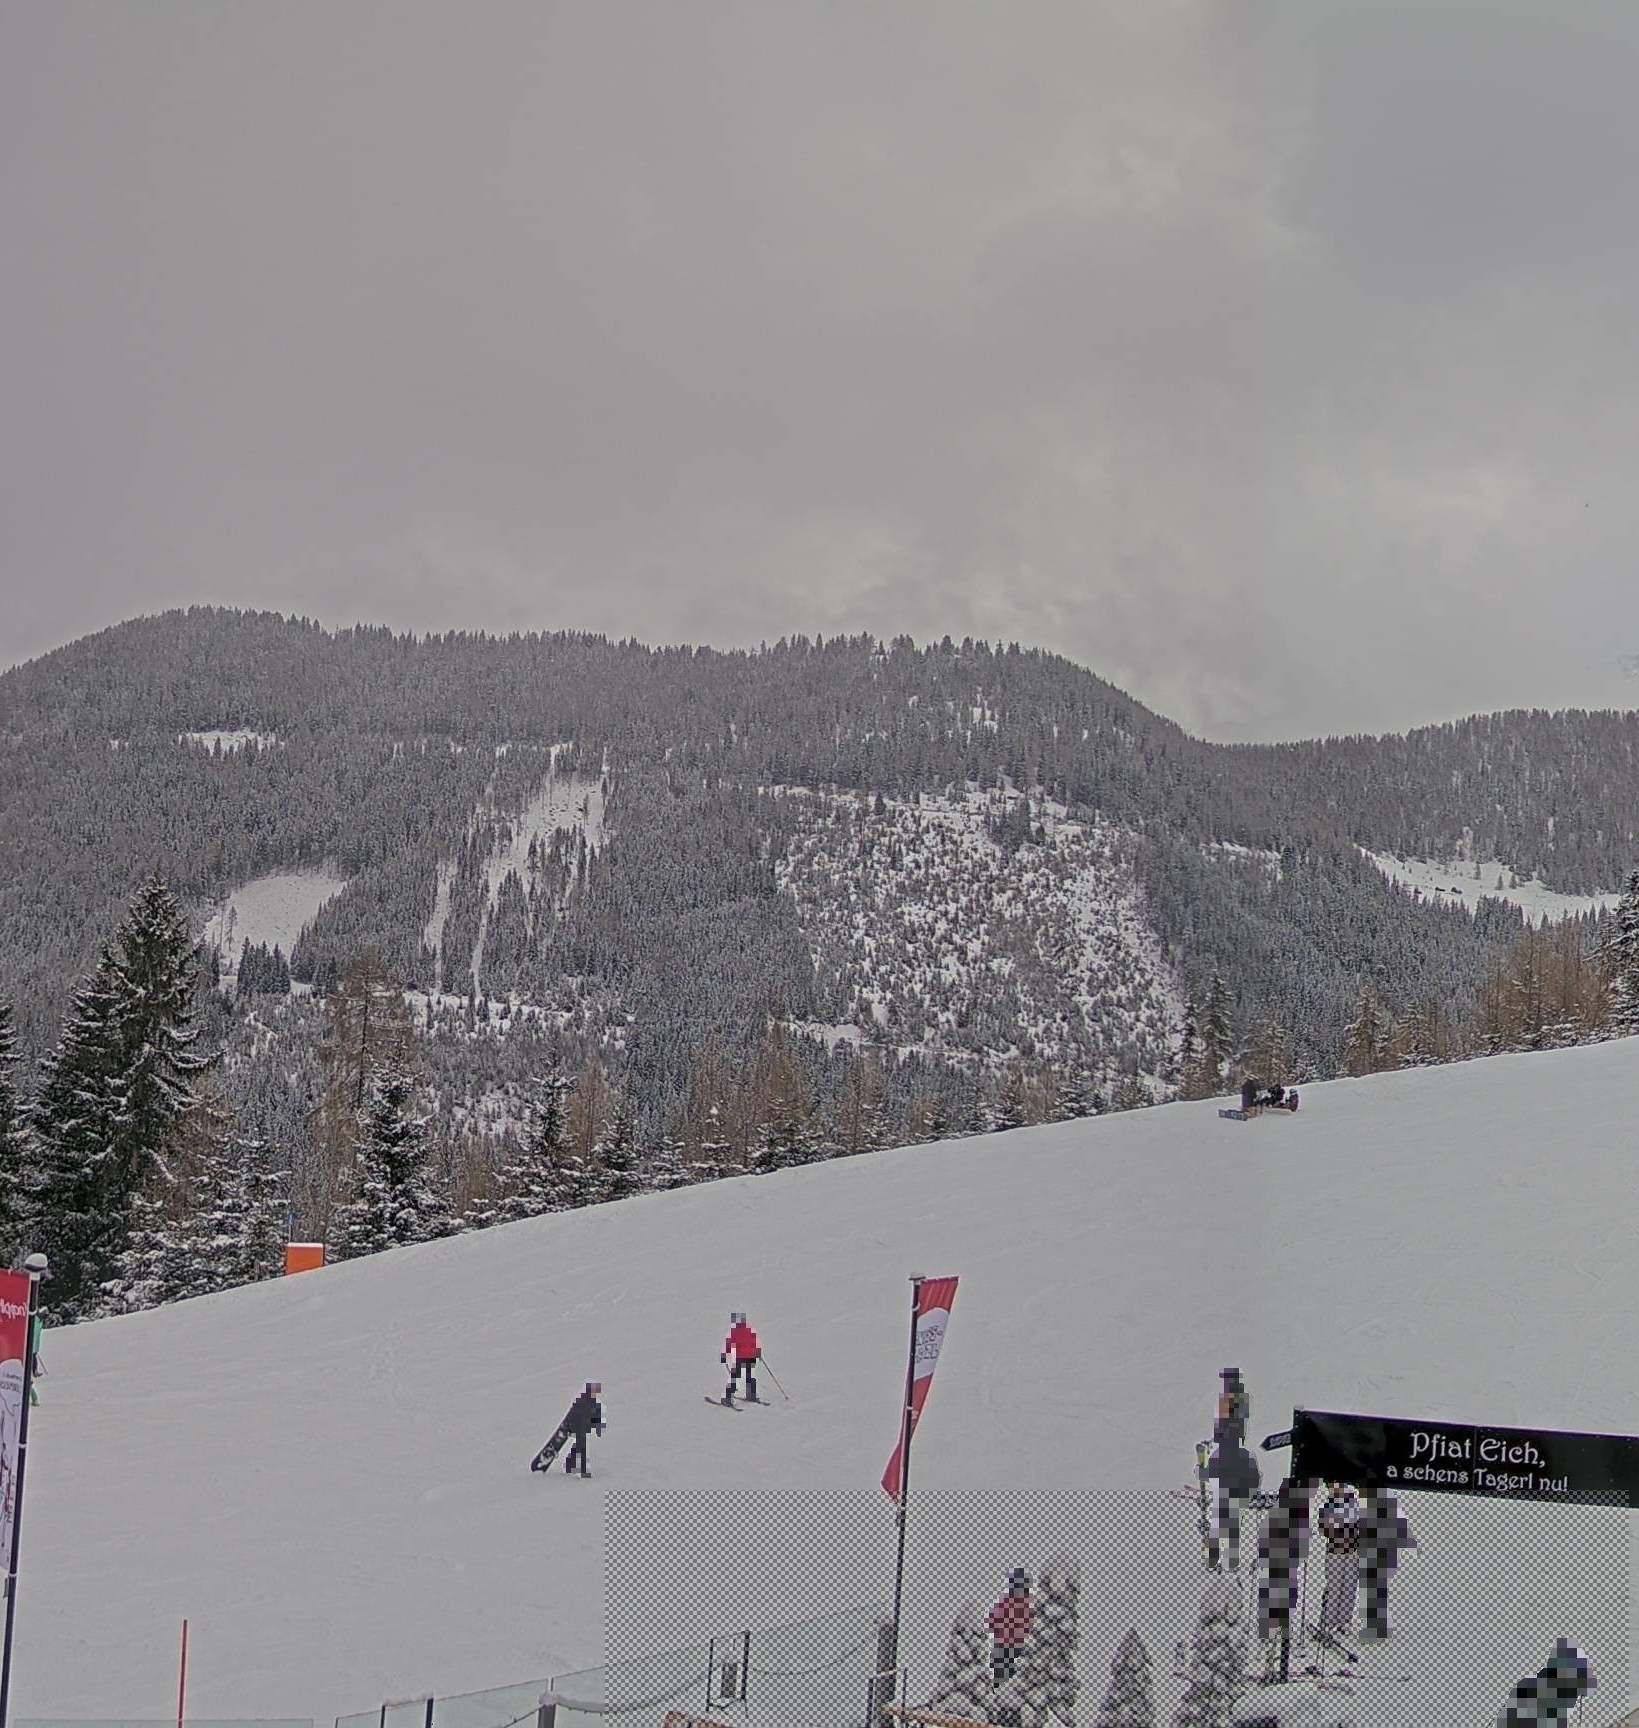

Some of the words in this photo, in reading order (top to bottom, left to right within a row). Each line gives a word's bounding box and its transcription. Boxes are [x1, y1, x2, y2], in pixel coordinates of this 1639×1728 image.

[1409, 1432, 1471, 1462] Pfiat
[1479, 1438, 1546, 1468] Eich,
[1386, 1465, 1398, 1478] a
[1402, 1464, 1469, 1484] schens
[1473, 1468, 1533, 1492] Tagerl
[1538, 1475, 1569, 1492] nu!
